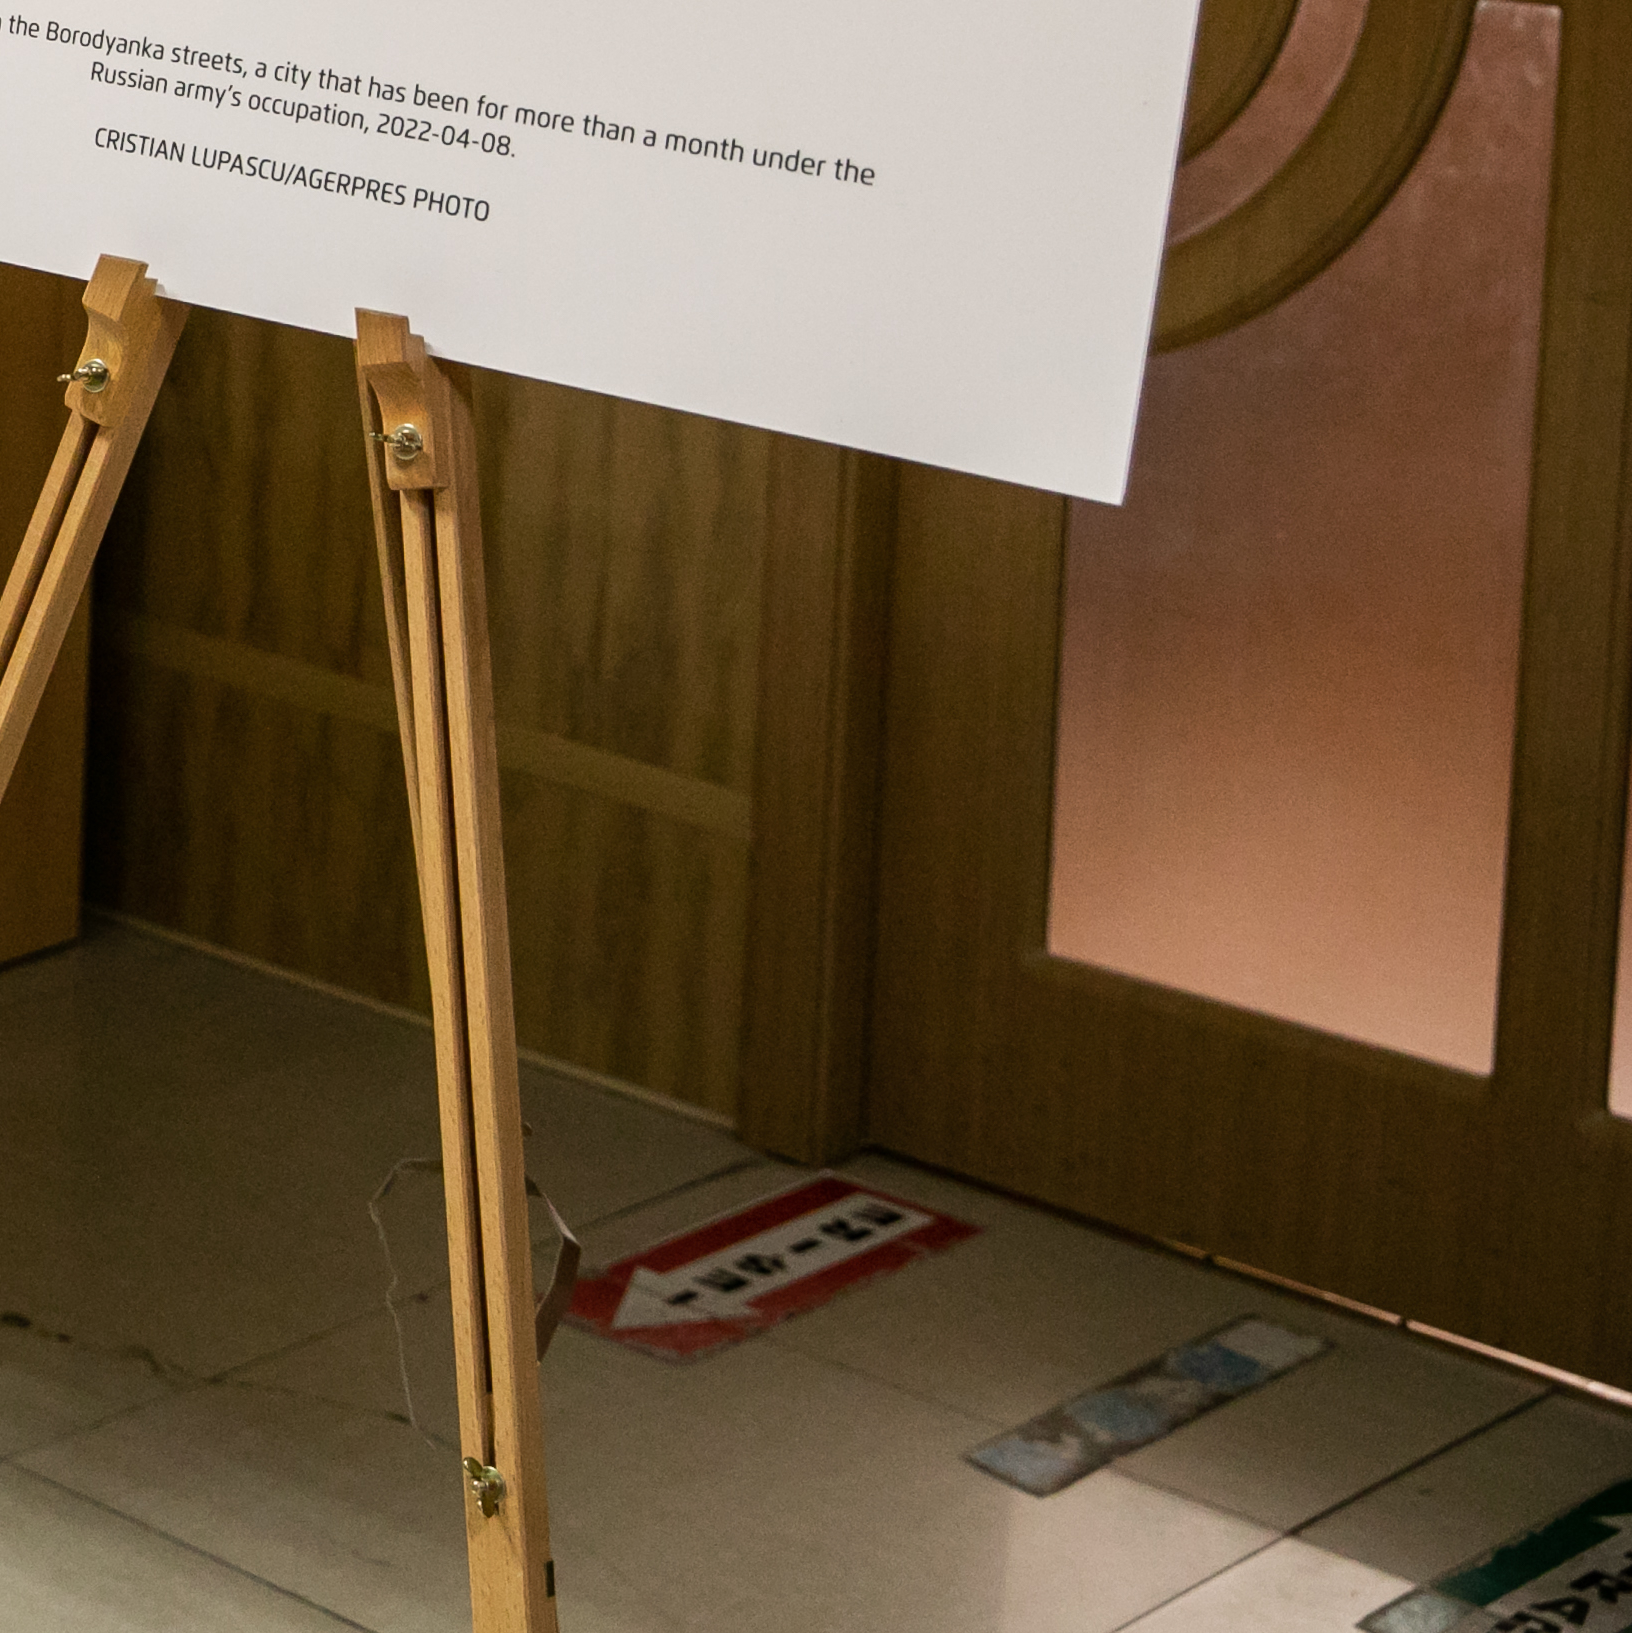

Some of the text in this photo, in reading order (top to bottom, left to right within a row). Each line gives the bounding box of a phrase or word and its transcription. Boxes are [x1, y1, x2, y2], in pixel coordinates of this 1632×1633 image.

[9, 15, 39, 38] the
[46, 21, 164, 60] Borodyanka
[171, 46, 247, 78] streets,
[255, 62, 267, 78] a
[274, 61, 311, 90] city
[319, 69, 362, 95] that
[368, 76, 406, 103] has
[413, 84, 468, 114] been
[477, 95, 508, 120] for
[515, 108, 574, 132] more
[583, 115, 635, 143] than
[643, 130, 656, 147] a
[665, 134, 744, 162] month
[753, 149, 826, 176] under
[835, 159, 875, 186] the
[91, 61, 167, 93] Russian
[248, 94, 368, 134] occupation,
[377, 113, 515, 157] 2022-04-08.
[95, 128, 489, 221] CRISTIAN LUPASCU/AGERPRES PHOTO
